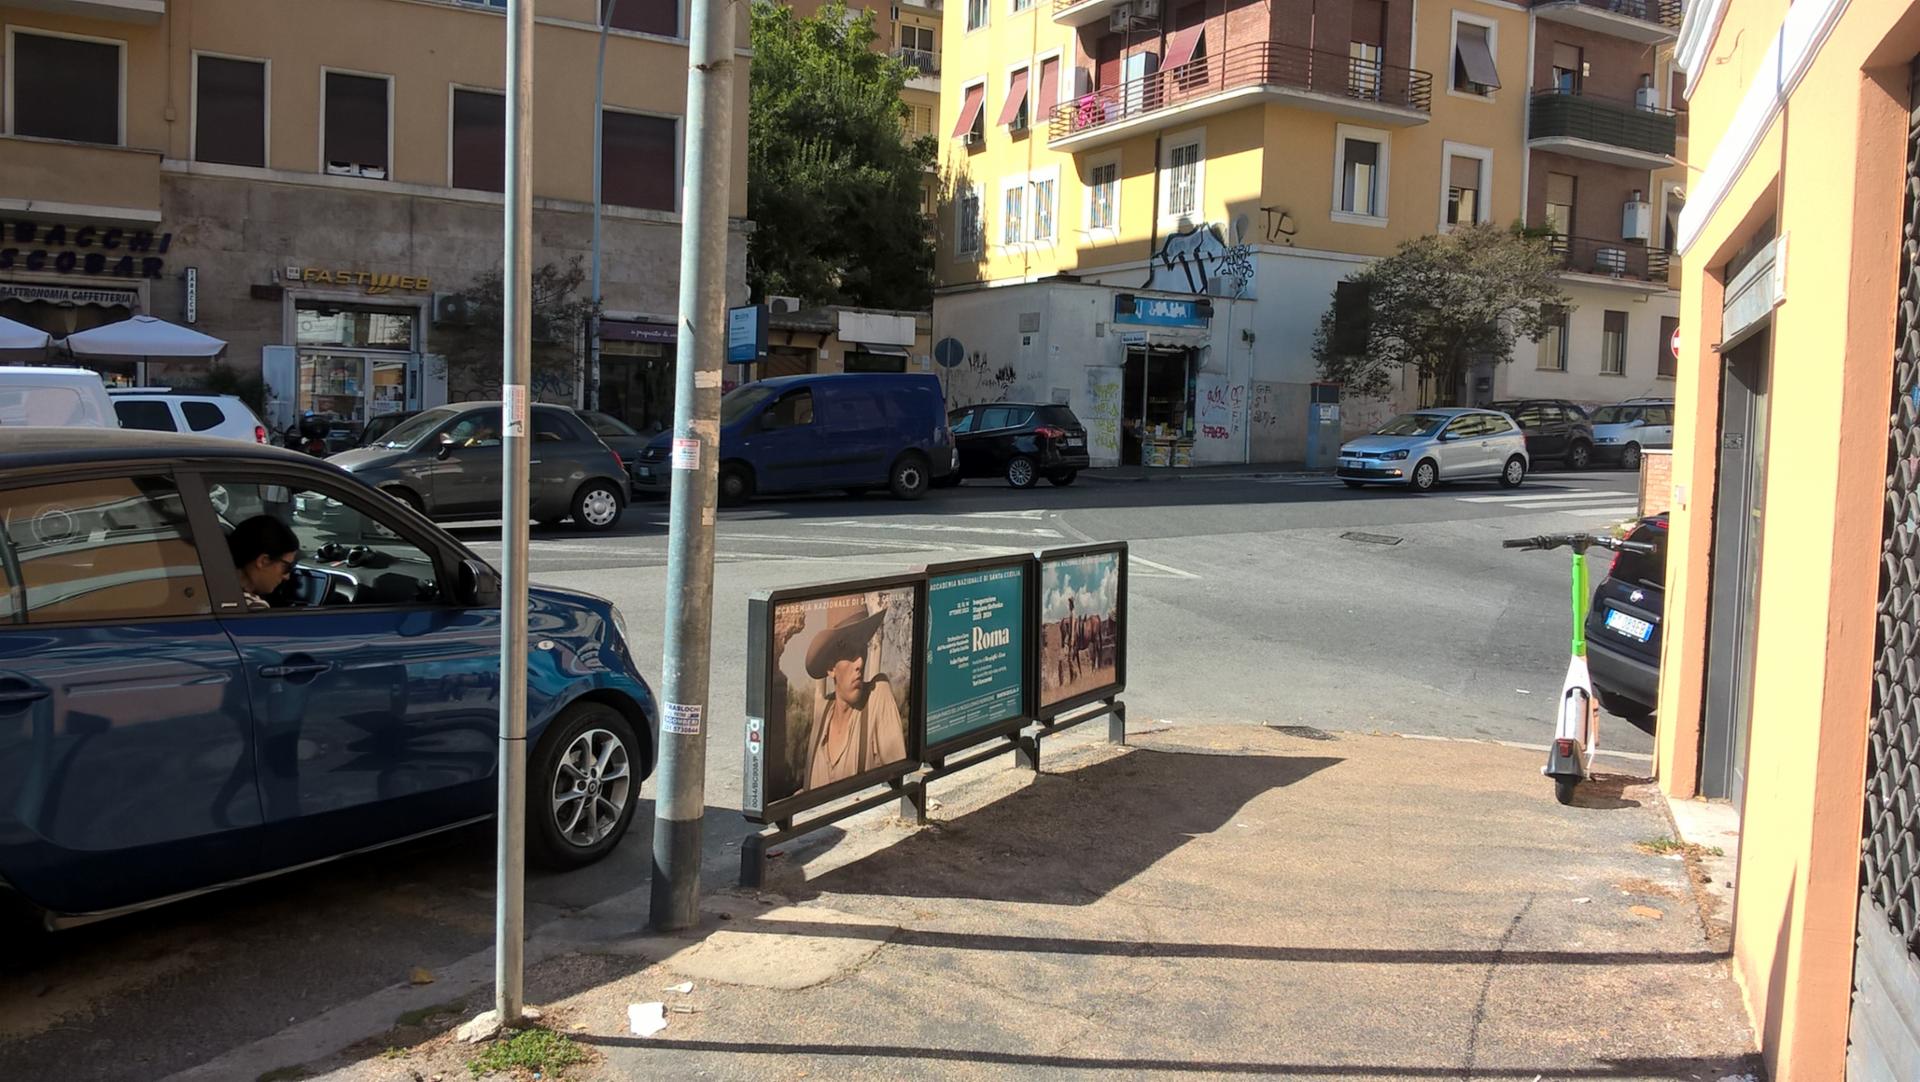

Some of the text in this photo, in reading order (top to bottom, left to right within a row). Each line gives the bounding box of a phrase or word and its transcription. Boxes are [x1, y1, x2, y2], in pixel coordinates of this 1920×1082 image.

[0, 222, 172, 253] BACCHI
[303, 267, 432, 294] FASTWEB
[0, 286, 133, 303] GASTRONOMIA CAFFETTERIA
[972, 626, 1009, 652] Roma
